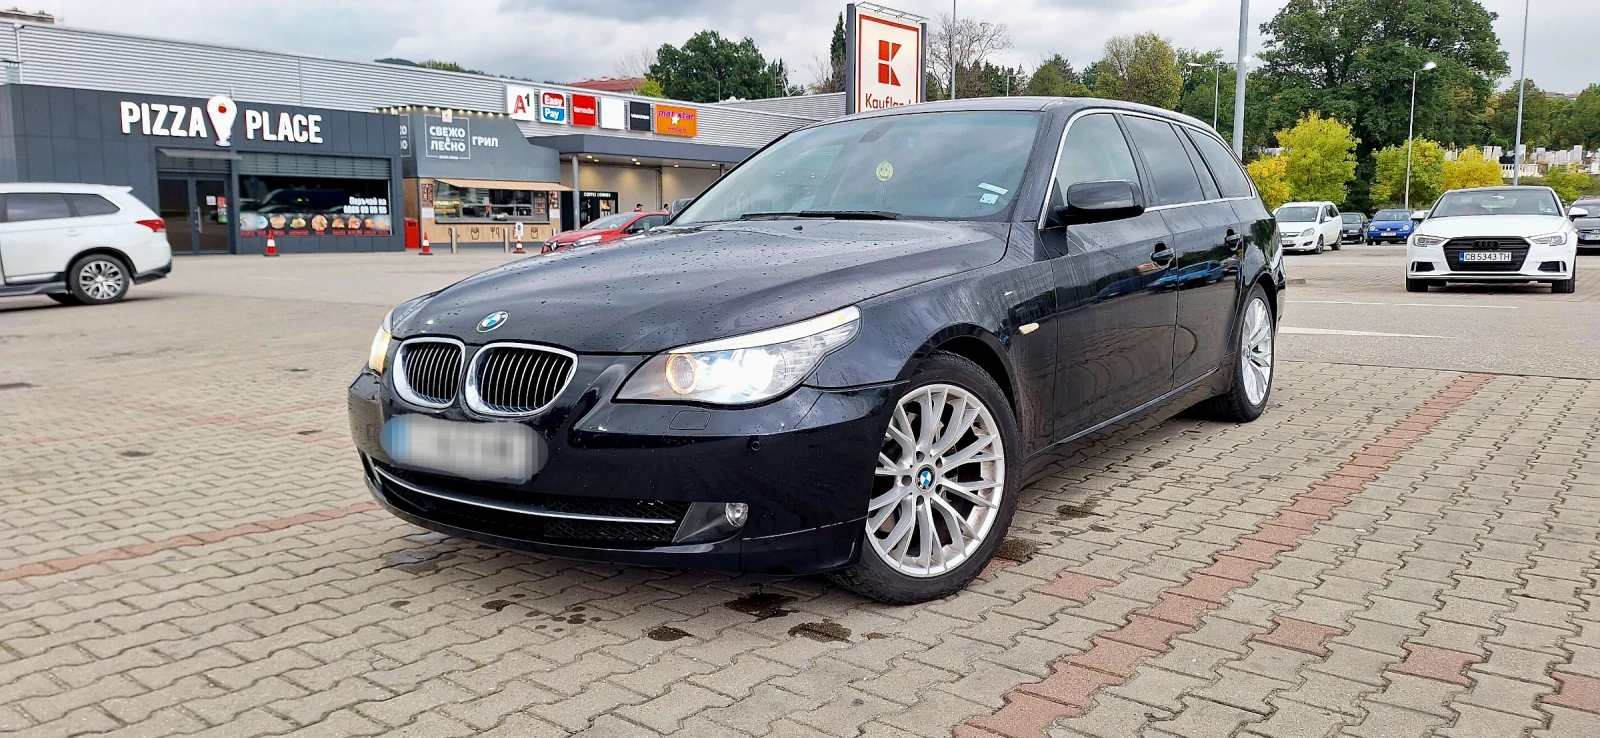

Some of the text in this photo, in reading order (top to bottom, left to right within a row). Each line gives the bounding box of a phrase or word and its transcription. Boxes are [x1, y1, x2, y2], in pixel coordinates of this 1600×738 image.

[513, 93, 531, 114] A1
[544, 95, 563, 107] Easy
[545, 108, 559, 120] Pay
[120, 101, 323, 144] PIZZA PLACE
[429, 125, 466, 138] СВЕЖО
[430, 141, 466, 152] ЛЕСНО
[472, 135, 499, 147] ГРИЛ
